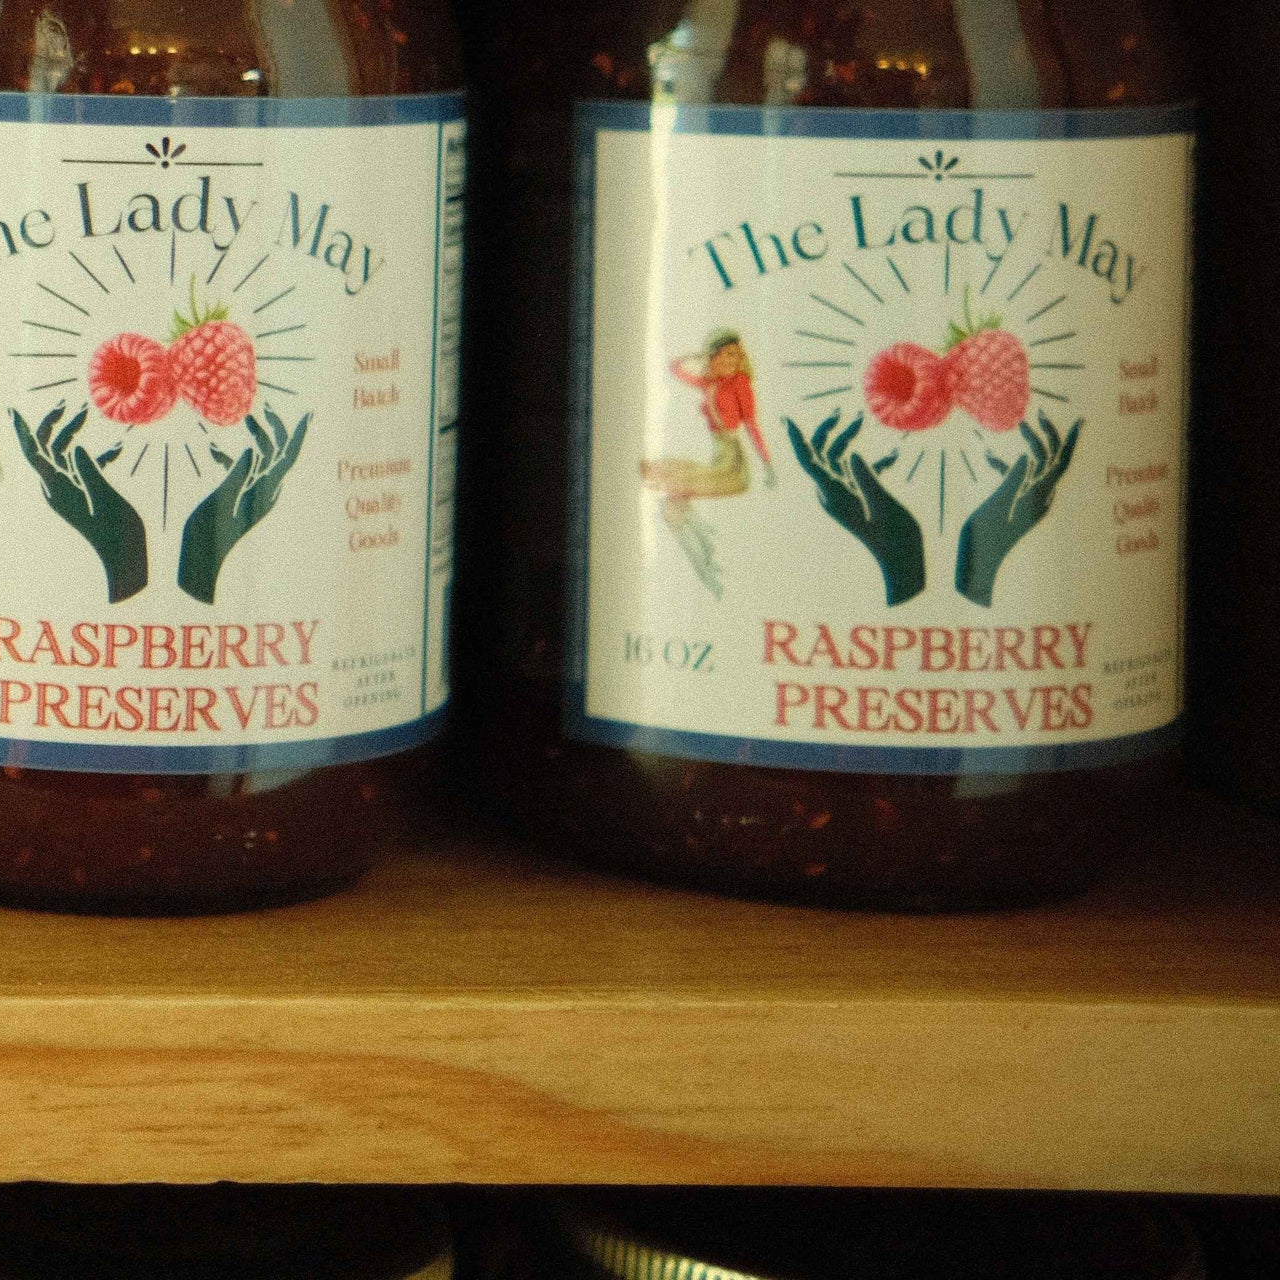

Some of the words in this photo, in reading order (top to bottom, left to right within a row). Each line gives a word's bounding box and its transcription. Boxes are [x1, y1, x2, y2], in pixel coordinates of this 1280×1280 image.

[75, 175, 257, 249] Lady
[274, 191, 387, 297] May
[690, 218, 828, 290] The
[849, 188, 1029, 260] Lady
[1047, 202, 1153, 303] May
[622, 633, 653, 663] 16
[664, 639, 715, 673] OZ
[762, 620, 1091, 673] RASPBERRY
[774, 682, 1091, 734] PRESERVES
